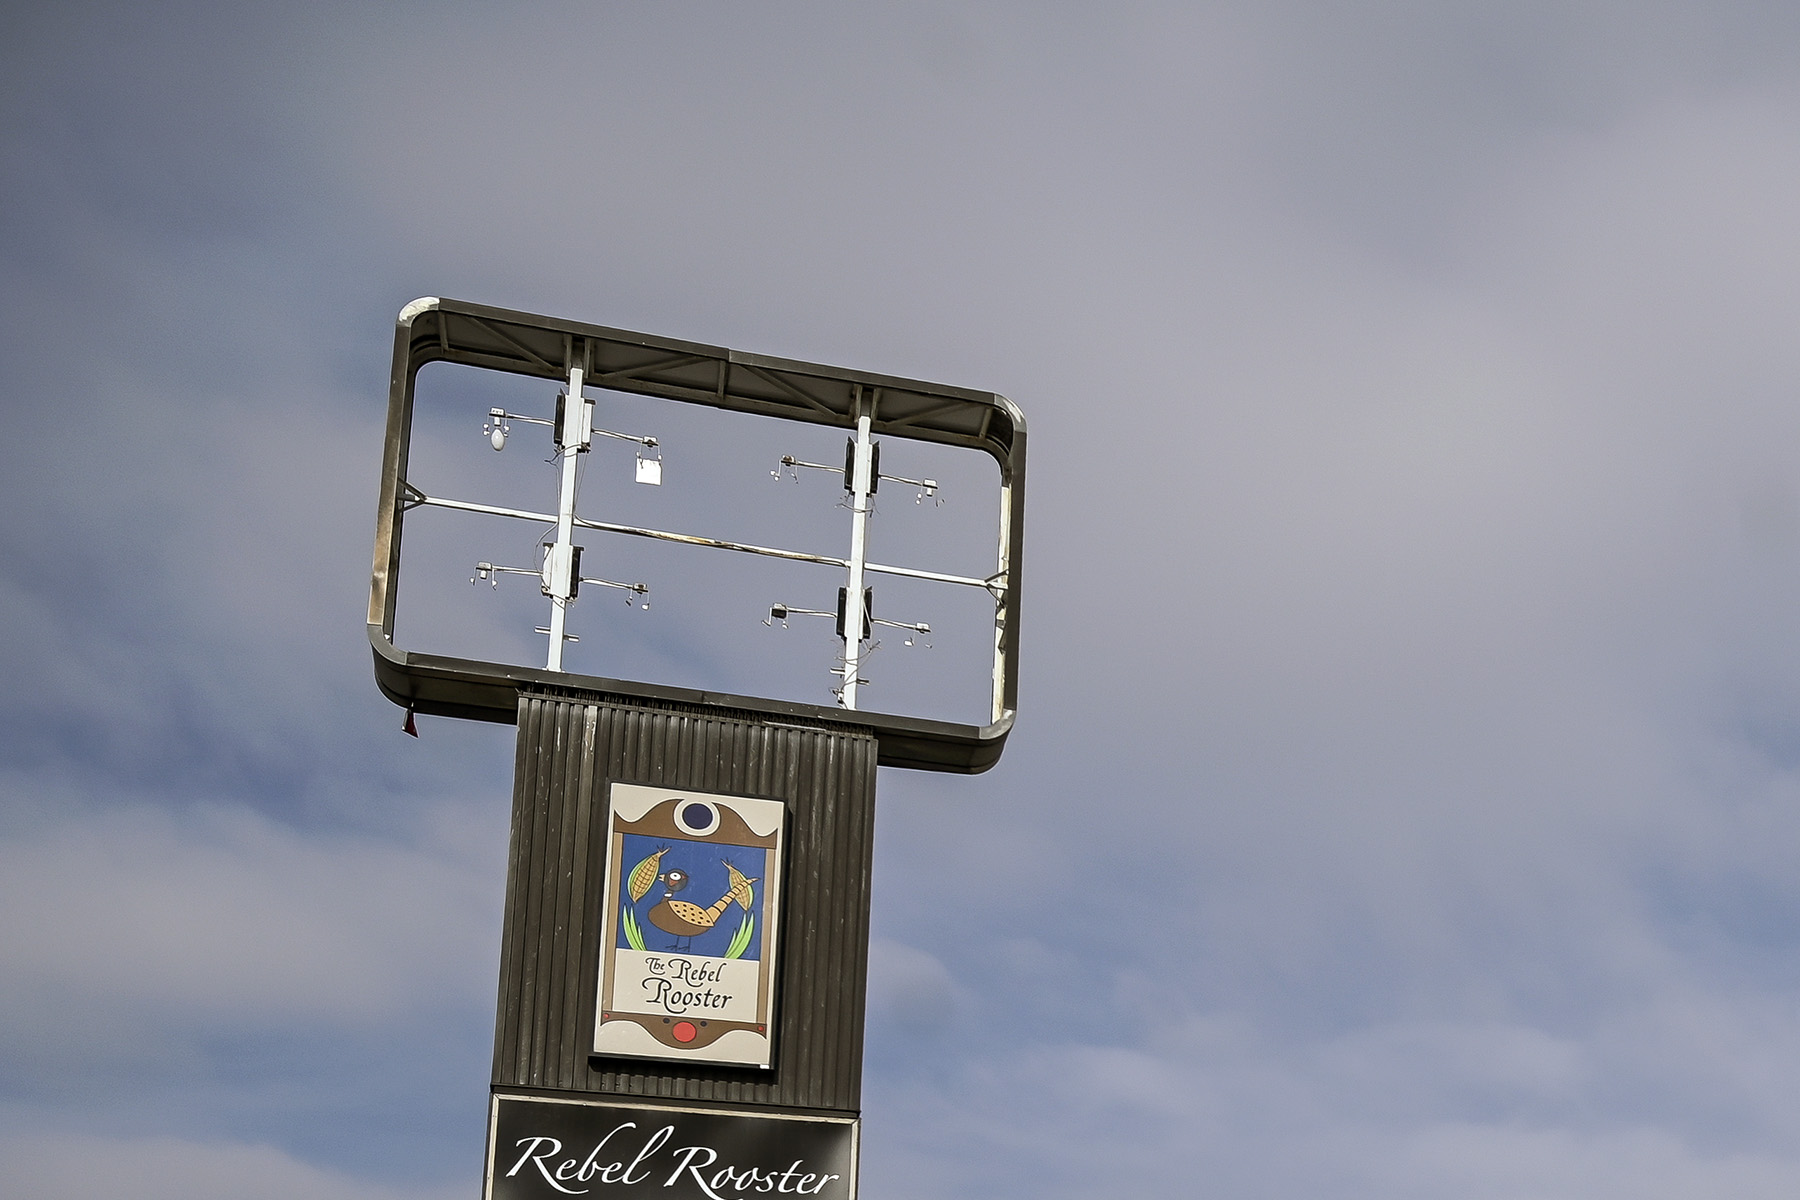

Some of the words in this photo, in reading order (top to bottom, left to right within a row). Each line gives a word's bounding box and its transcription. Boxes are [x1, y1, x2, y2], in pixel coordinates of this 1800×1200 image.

[645, 957, 666, 976] The
[668, 958, 727, 988] Rebel
[641, 977, 733, 1014] Rooster
[505, 1121, 675, 1195] Rebel
